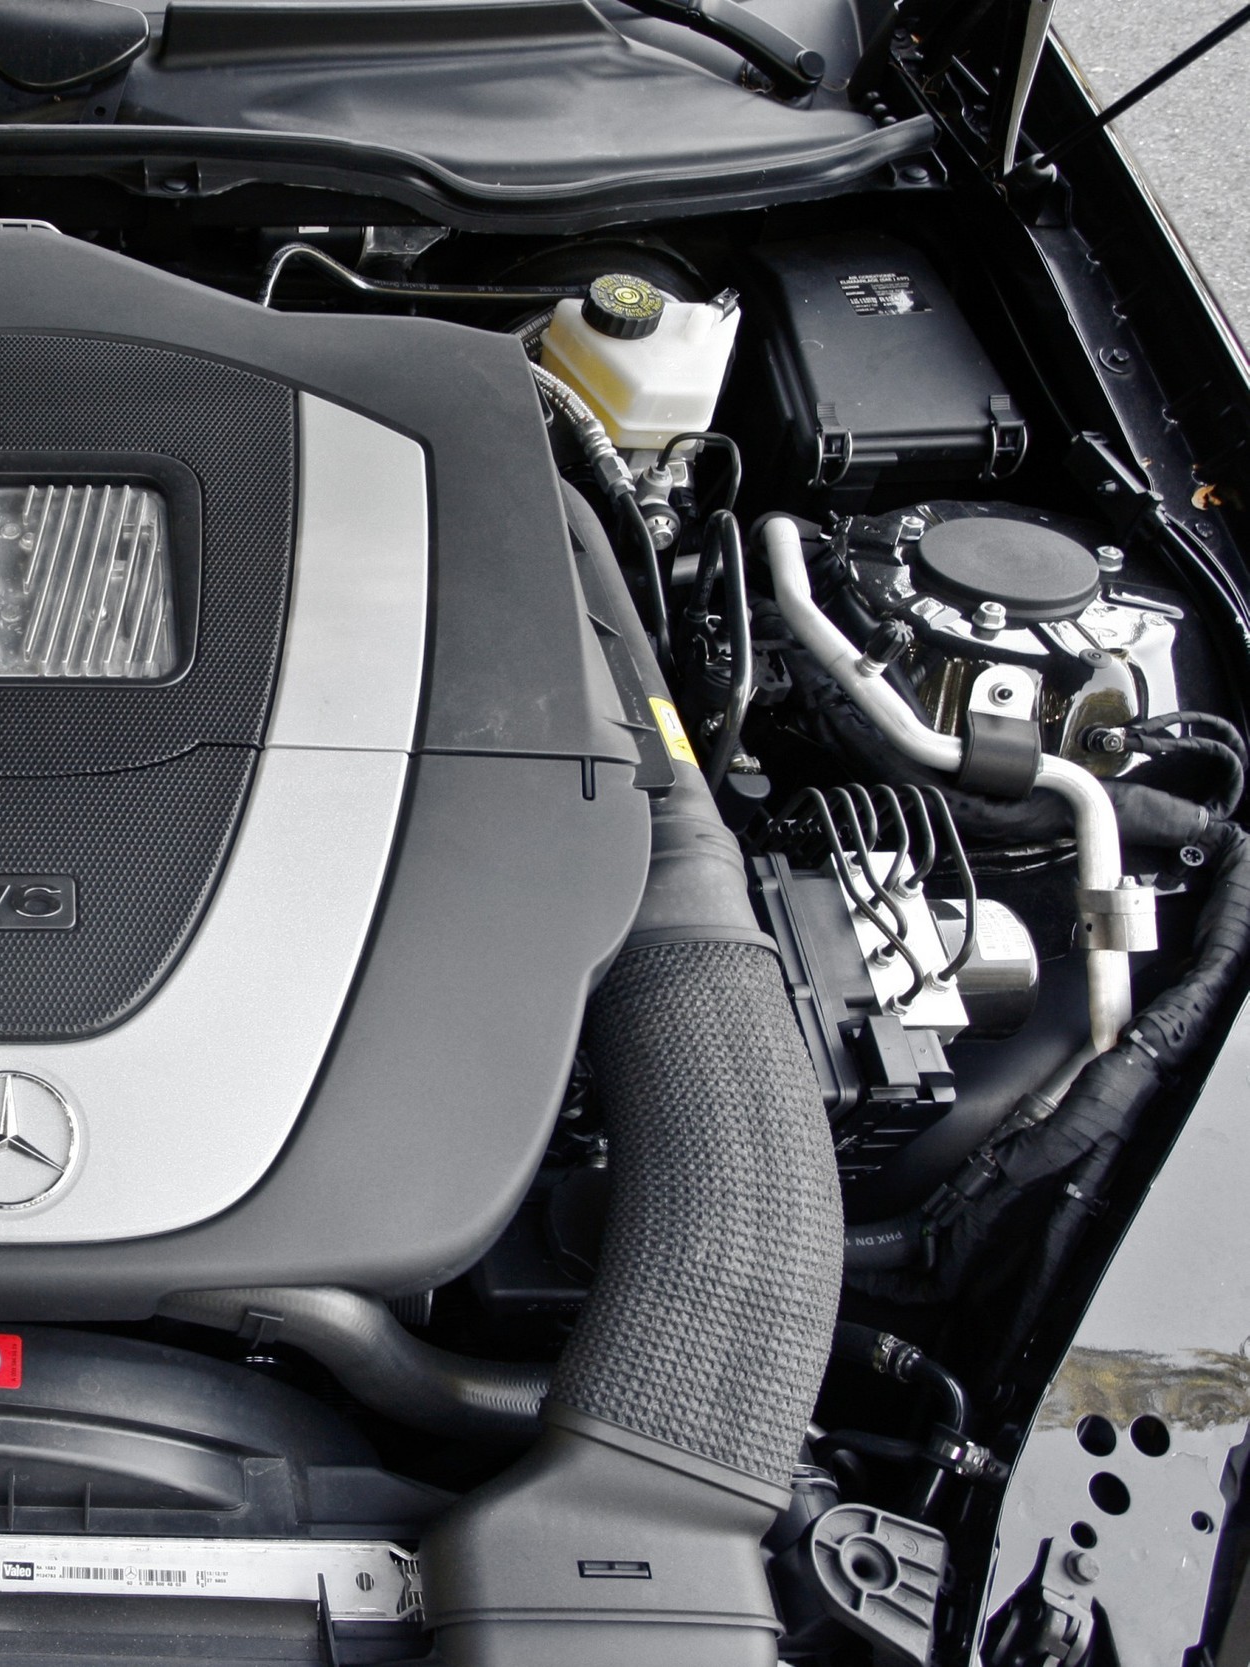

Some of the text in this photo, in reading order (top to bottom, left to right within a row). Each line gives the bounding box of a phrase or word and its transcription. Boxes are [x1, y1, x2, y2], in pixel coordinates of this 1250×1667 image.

[855, 1236, 875, 1247] DN
[875, 1230, 903, 1245] PHX
[2, 1563, 32, 1578] Valeo
